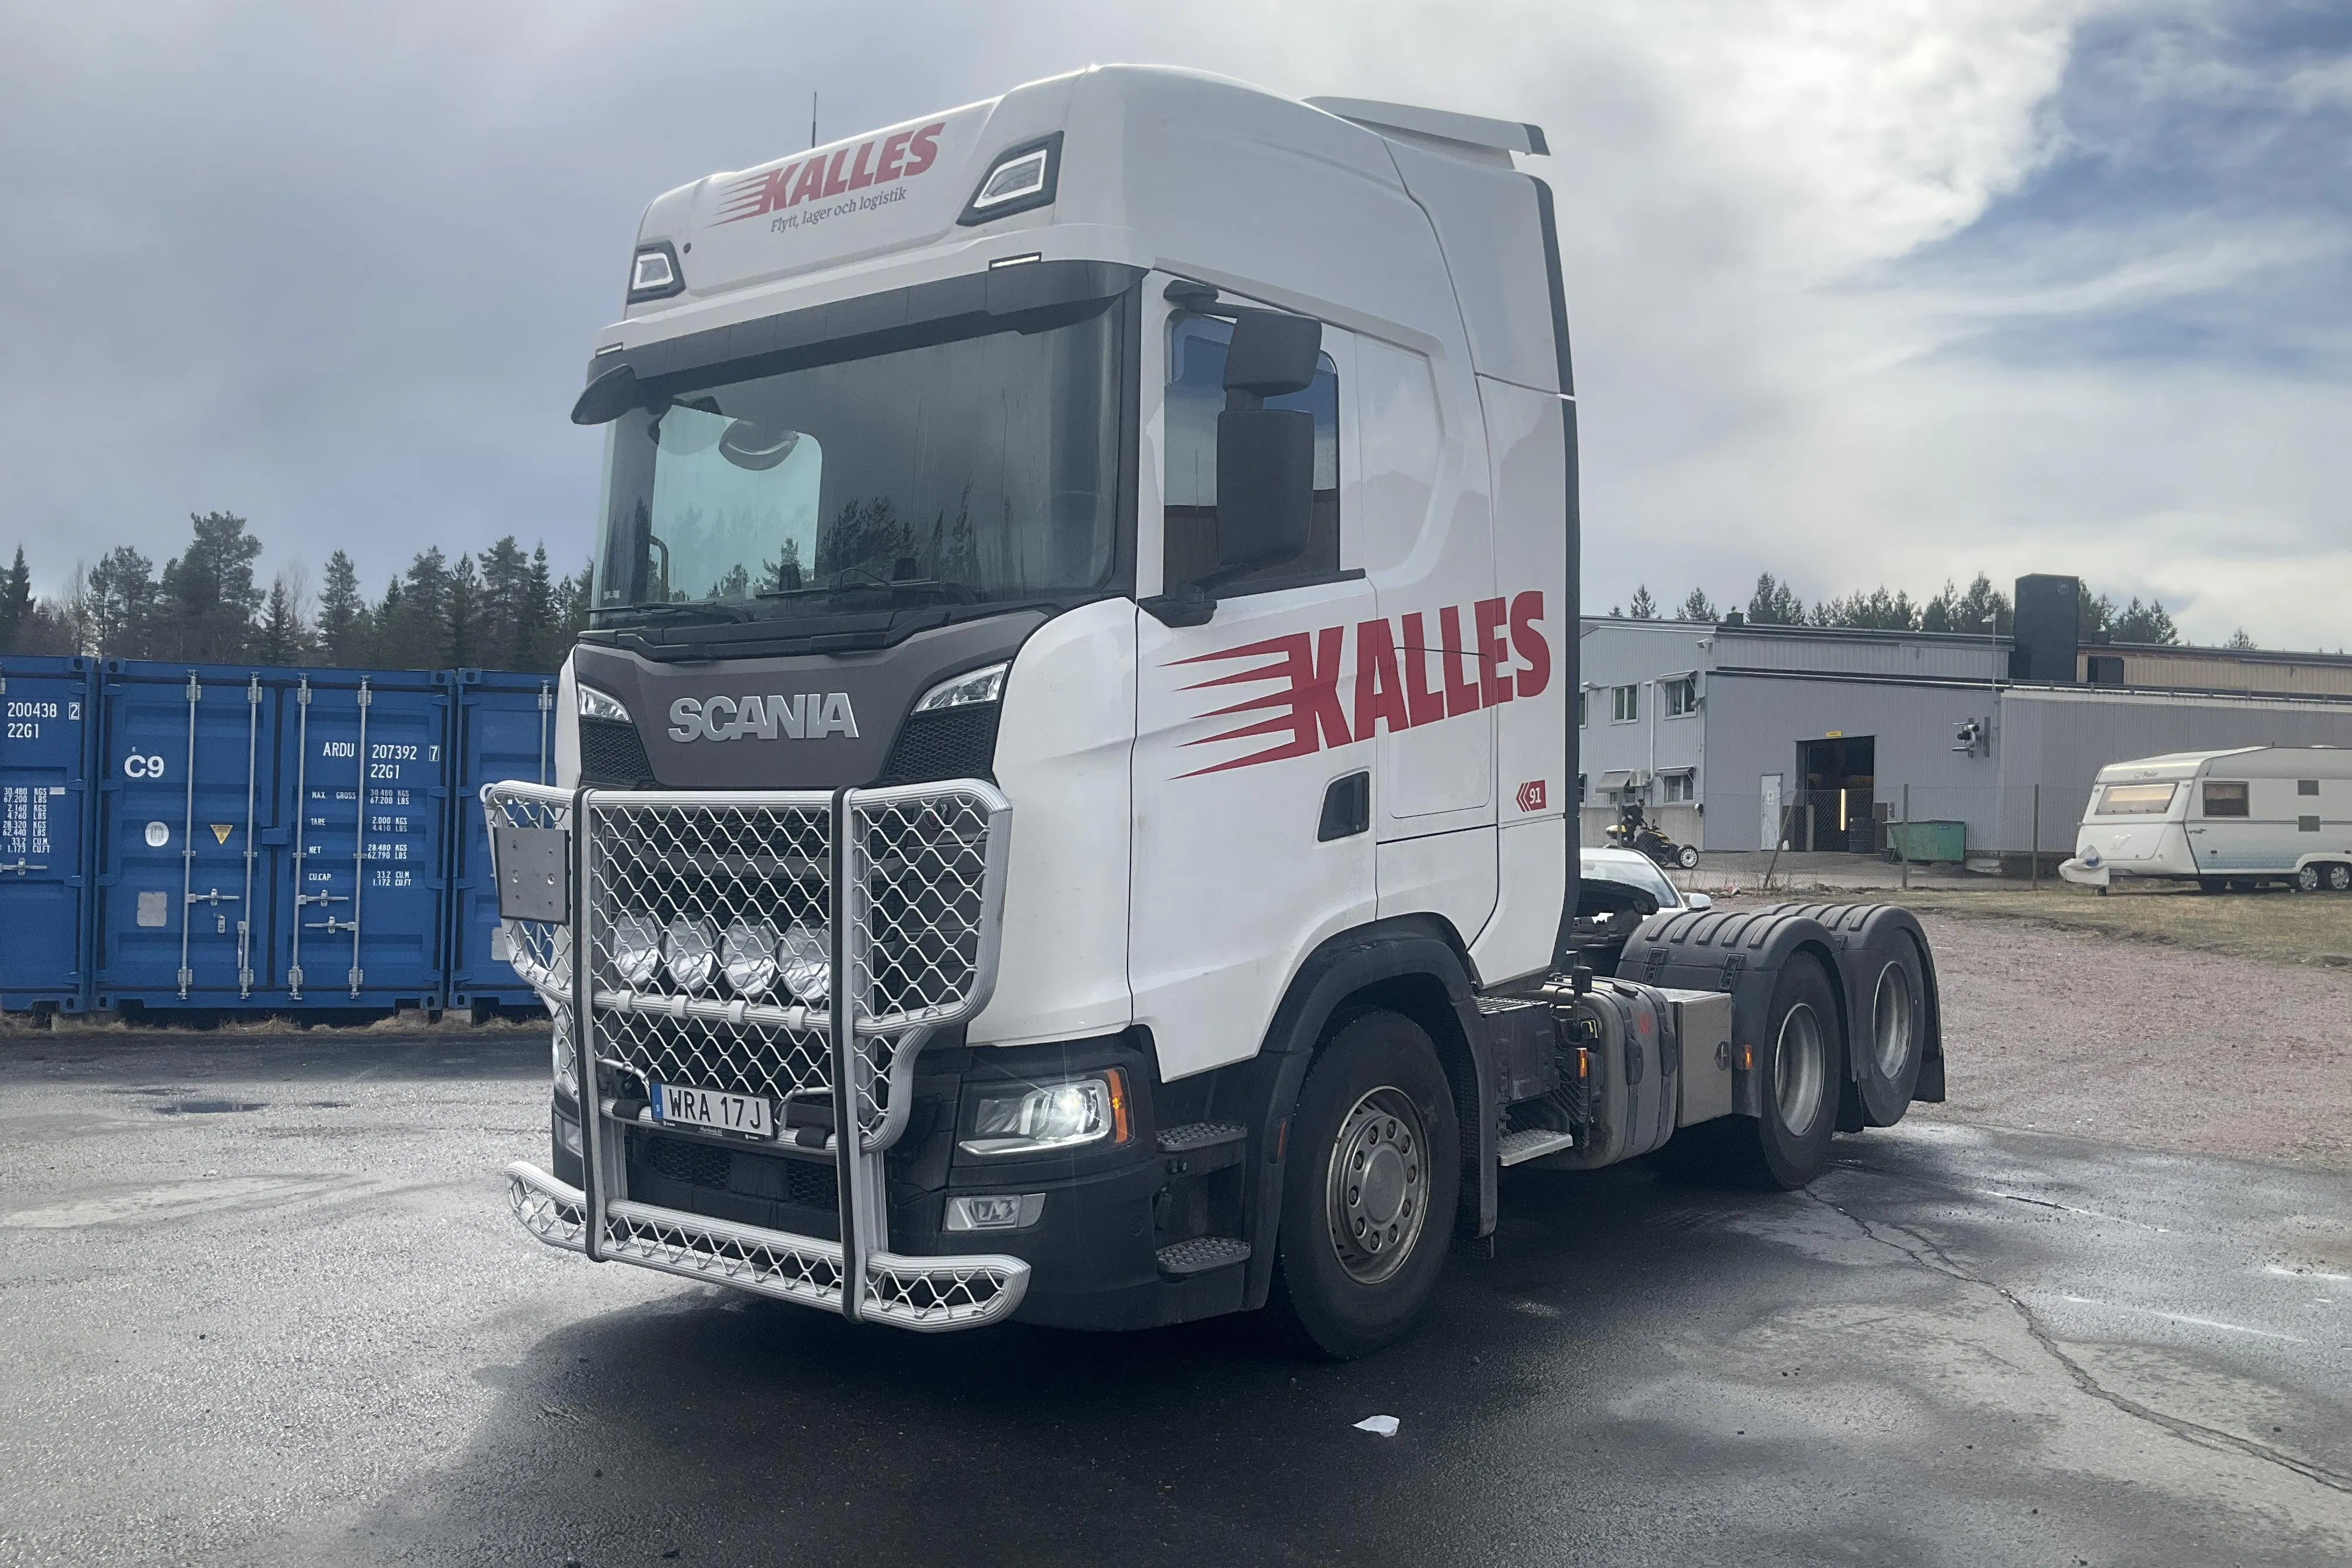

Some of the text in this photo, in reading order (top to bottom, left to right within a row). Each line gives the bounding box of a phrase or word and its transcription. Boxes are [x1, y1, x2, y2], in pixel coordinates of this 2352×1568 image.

[758, 122, 946, 215] KALLES
[770, 186, 907, 233] Flytt, lager och logistik
[1280, 590, 1550, 753] KALLES
[7, 702, 79, 719] 200438 2
[668, 692, 860, 743] SCANIA
[7, 723, 39, 738] 22G1
[323, 741, 438, 761] ARDU 207392 7
[124, 754, 164, 778] C9
[370, 763, 400, 779] 22G1
[4, 787, 47, 796] 30.480 KGS
[335, 792, 356, 800] GROSS
[1529, 787, 1542, 804] 91
[3, 795, 47, 803] 67.200 LBS
[397, 797, 410, 805] LBS
[8, 804, 47, 812] 2.160 KGS
[7, 811, 47, 820] 4.760 LBS
[3, 820, 47, 829] 28.320 KGS
[310, 818, 326, 826] TARE
[395, 817, 408, 825] KGS
[2, 828, 46, 836] 62.440 LBS
[11, 837, 26, 845] 33.2
[8, 845, 26, 853] 1.173
[309, 846, 321, 854] NET
[367, 851, 391, 859] 62.790
[376, 871, 391, 879] 33.2
[372, 878, 391, 887] 1.172
[668, 1088, 761, 1129] WRA 17J
